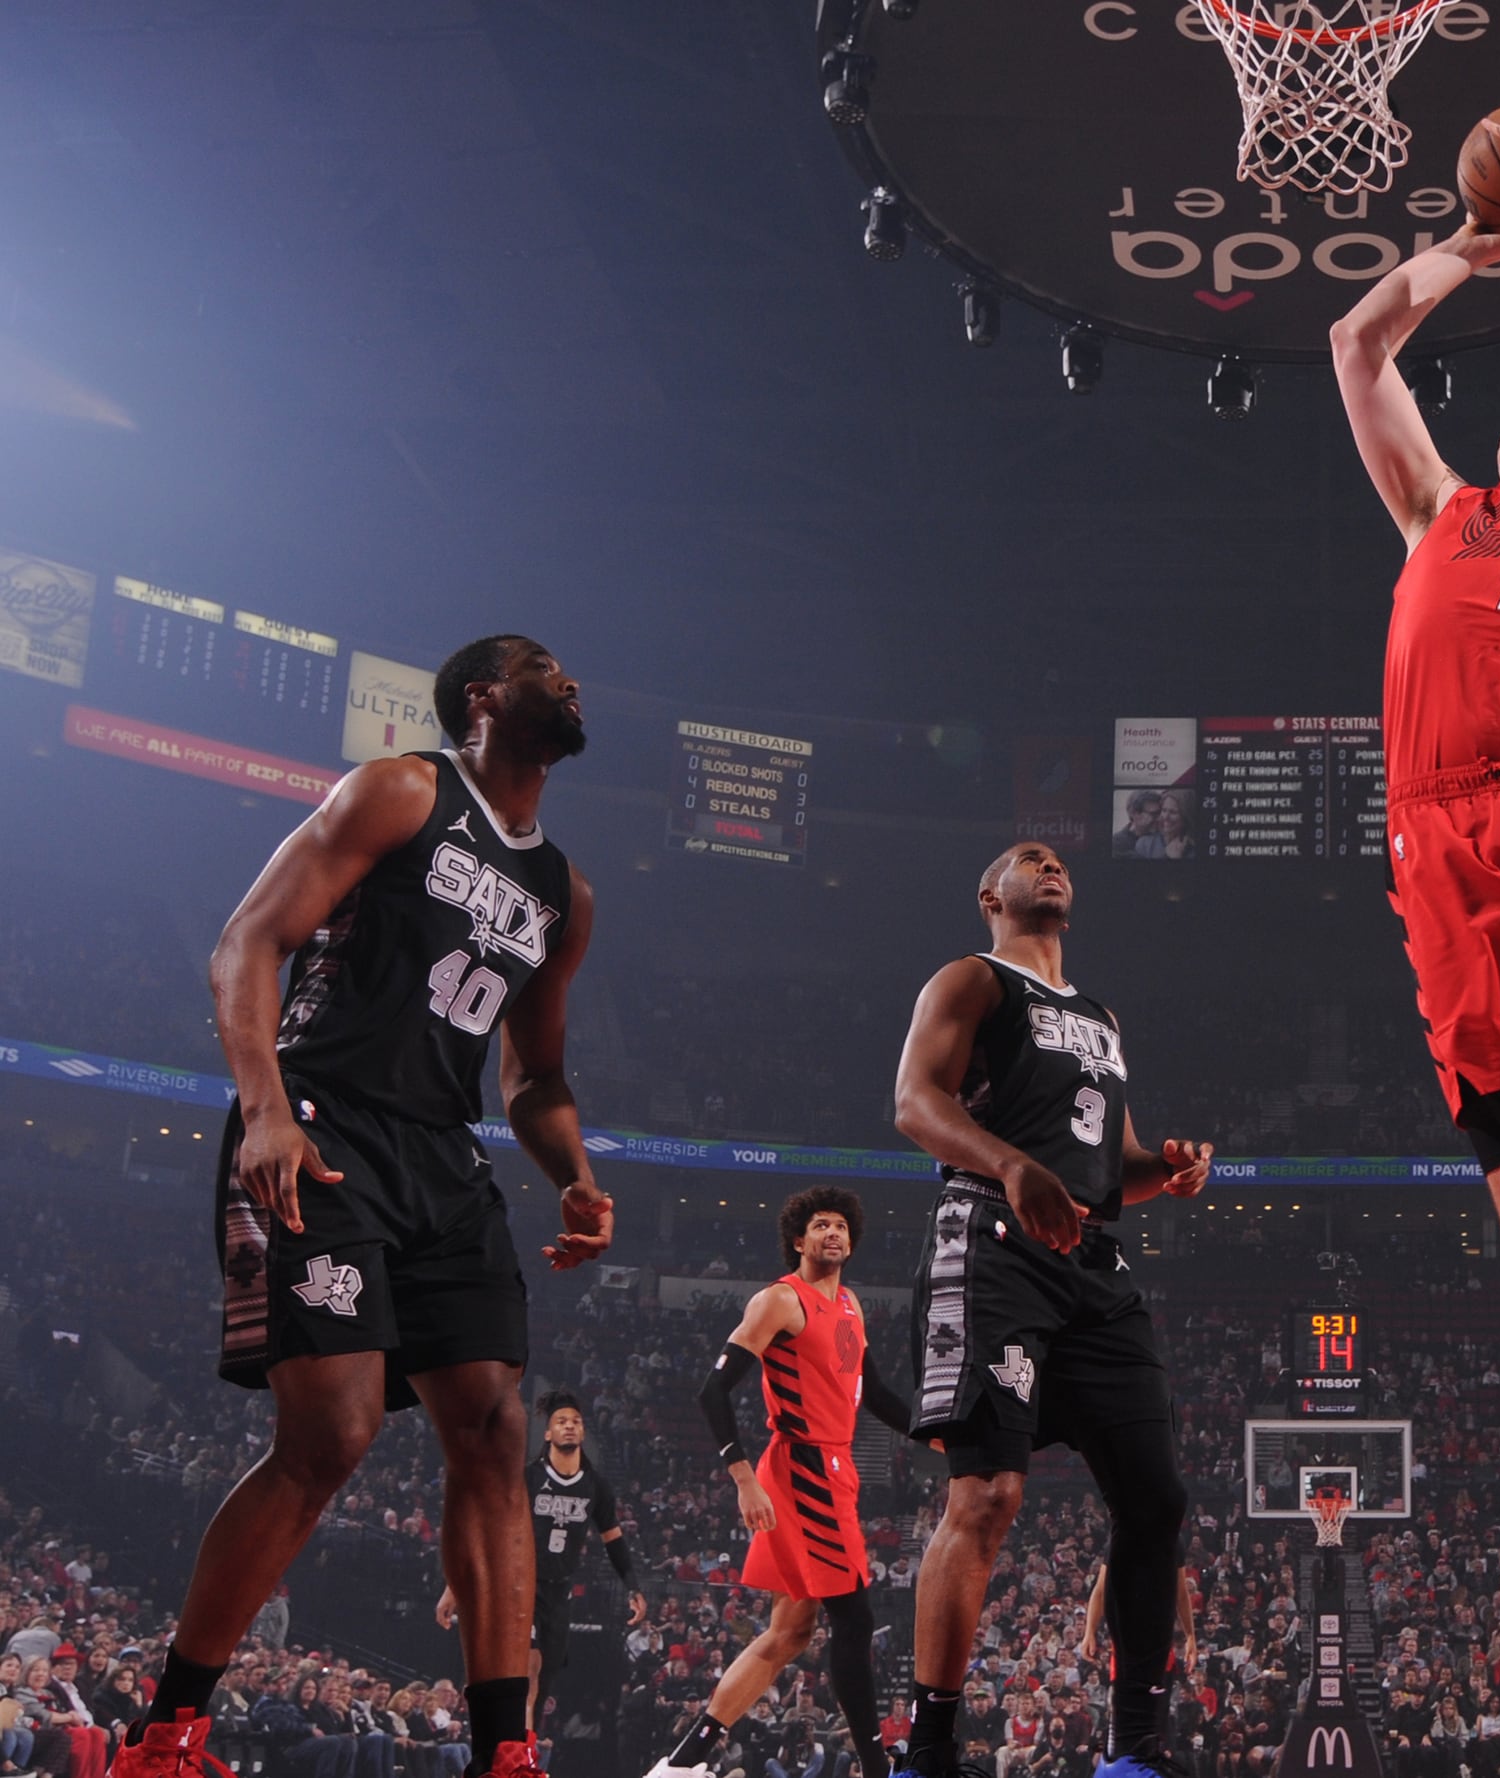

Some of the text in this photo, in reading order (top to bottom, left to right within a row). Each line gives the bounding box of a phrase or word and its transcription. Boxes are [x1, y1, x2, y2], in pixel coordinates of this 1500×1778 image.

[1110, 187, 1457, 224] enter
[147, 583, 193, 604] HOME
[27, 653, 59, 675] NOW
[349, 688, 437, 728] ULTRA
[1123, 728, 1162, 737] Health
[1292, 717, 1381, 730] STATS CENTRAL
[687, 723, 804, 752] HUSTLEBOARD
[1123, 738, 1176, 747] insurance
[75, 720, 333, 793] WE ARE ALL PART OF RIP CITY
[682, 741, 733, 758] BLAZERS
[1227, 751, 1252, 761] FIELD
[1254, 751, 1277, 761] GOAL
[1308, 749, 1323, 760] 25
[1338, 749, 1346, 760] 0
[688, 755, 808, 788] 0 BLOCKED SHOTS 0
[770, 756, 805, 769] GUEST
[1121, 755, 1169, 772] moda
[1308, 765, 1323, 776] 50
[1338, 765, 1346, 776] 0
[688, 776, 807, 807] 4 REBOUNDS 3
[685, 794, 805, 826] 0 STEALS 0
[1315, 797, 1324, 808] 0
[1016, 813, 1086, 841] ripcity
[1315, 812, 1323, 823] 0
[714, 820, 765, 842] TOTAL
[1209, 829, 1217, 840] 0
[1315, 829, 1323, 840] 0
[1209, 845, 1217, 856] 0
[1225, 846, 1243, 856] 2ND
[1315, 844, 1323, 855] 0
[1339, 844, 1347, 855] 0
[426, 842, 560, 967] SATX
[428, 949, 508, 1035] 40
[1028, 1003, 1127, 1082] SATX
[107, 1079, 162, 1095] PAYMENTS
[108, 1063, 199, 1092] RIVERSIDE
[1071, 1086, 1106, 1146] 3
[626, 1139, 709, 1158] RIVERSIDE
[626, 1151, 676, 1164] PAYMENTS
[733, 1150, 932, 1174] YOUR PREMIERE PARTNER
[1214, 1165, 1256, 1177] YOUR
[1260, 1164, 1336, 1177] PREMIERE
[1340, 1165, 1409, 1177] PARTNER
[1413, 1165, 1429, 1176] IN
[1312, 1315, 1357, 1335] 9:31
[1319, 1335, 1353, 1371] 14
[1313, 1378, 1362, 1389] TISSOT
[534, 1493, 591, 1527] SATX
